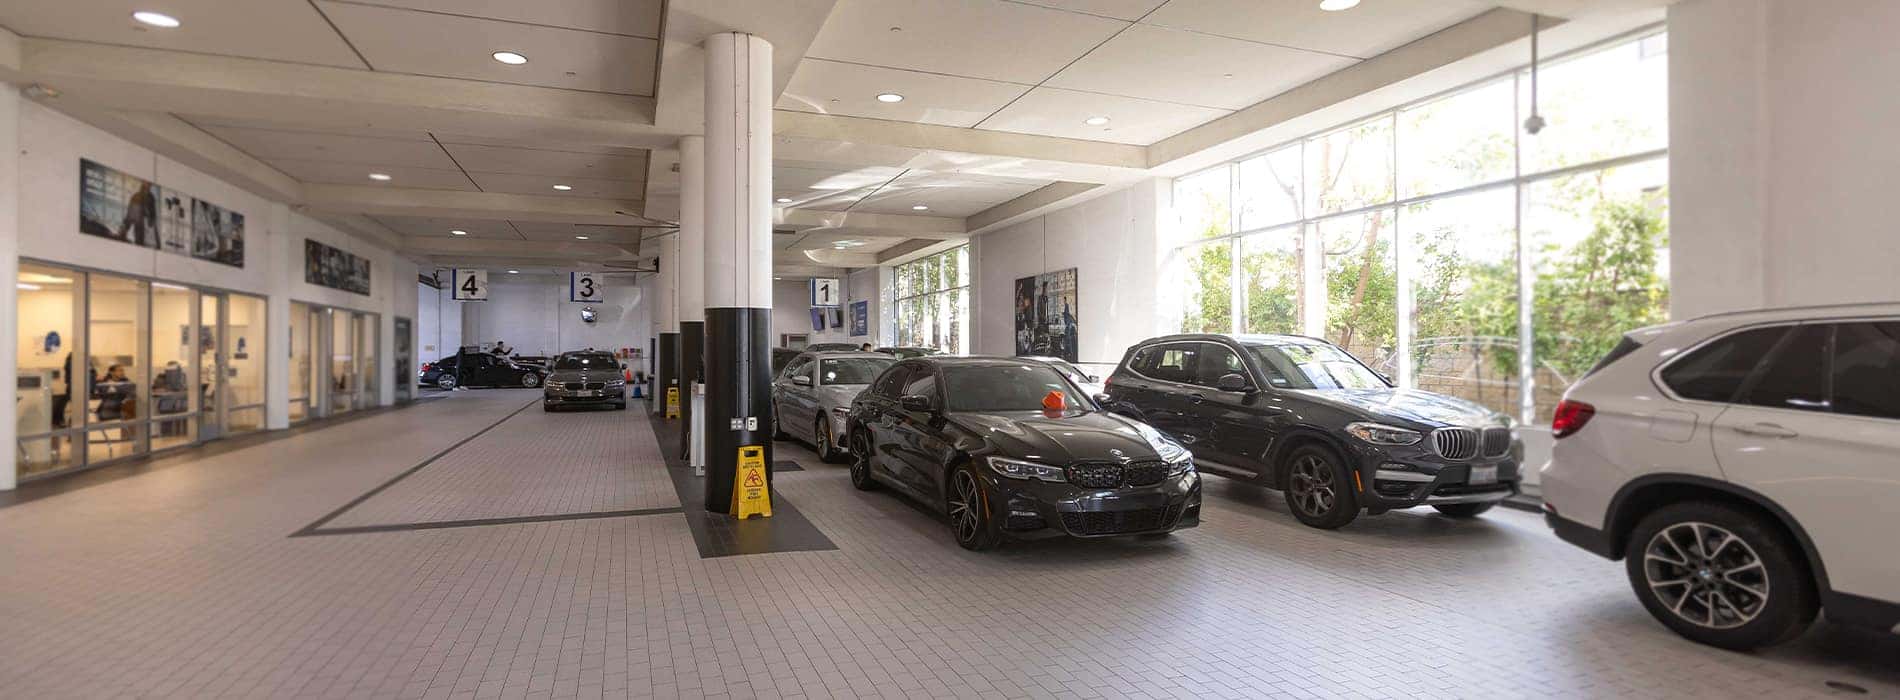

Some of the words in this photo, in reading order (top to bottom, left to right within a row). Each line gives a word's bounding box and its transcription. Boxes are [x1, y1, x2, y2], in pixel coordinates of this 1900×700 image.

[461, 275, 478, 295] 4
[580, 278, 594, 297] 3
[820, 284, 829, 301] 1
